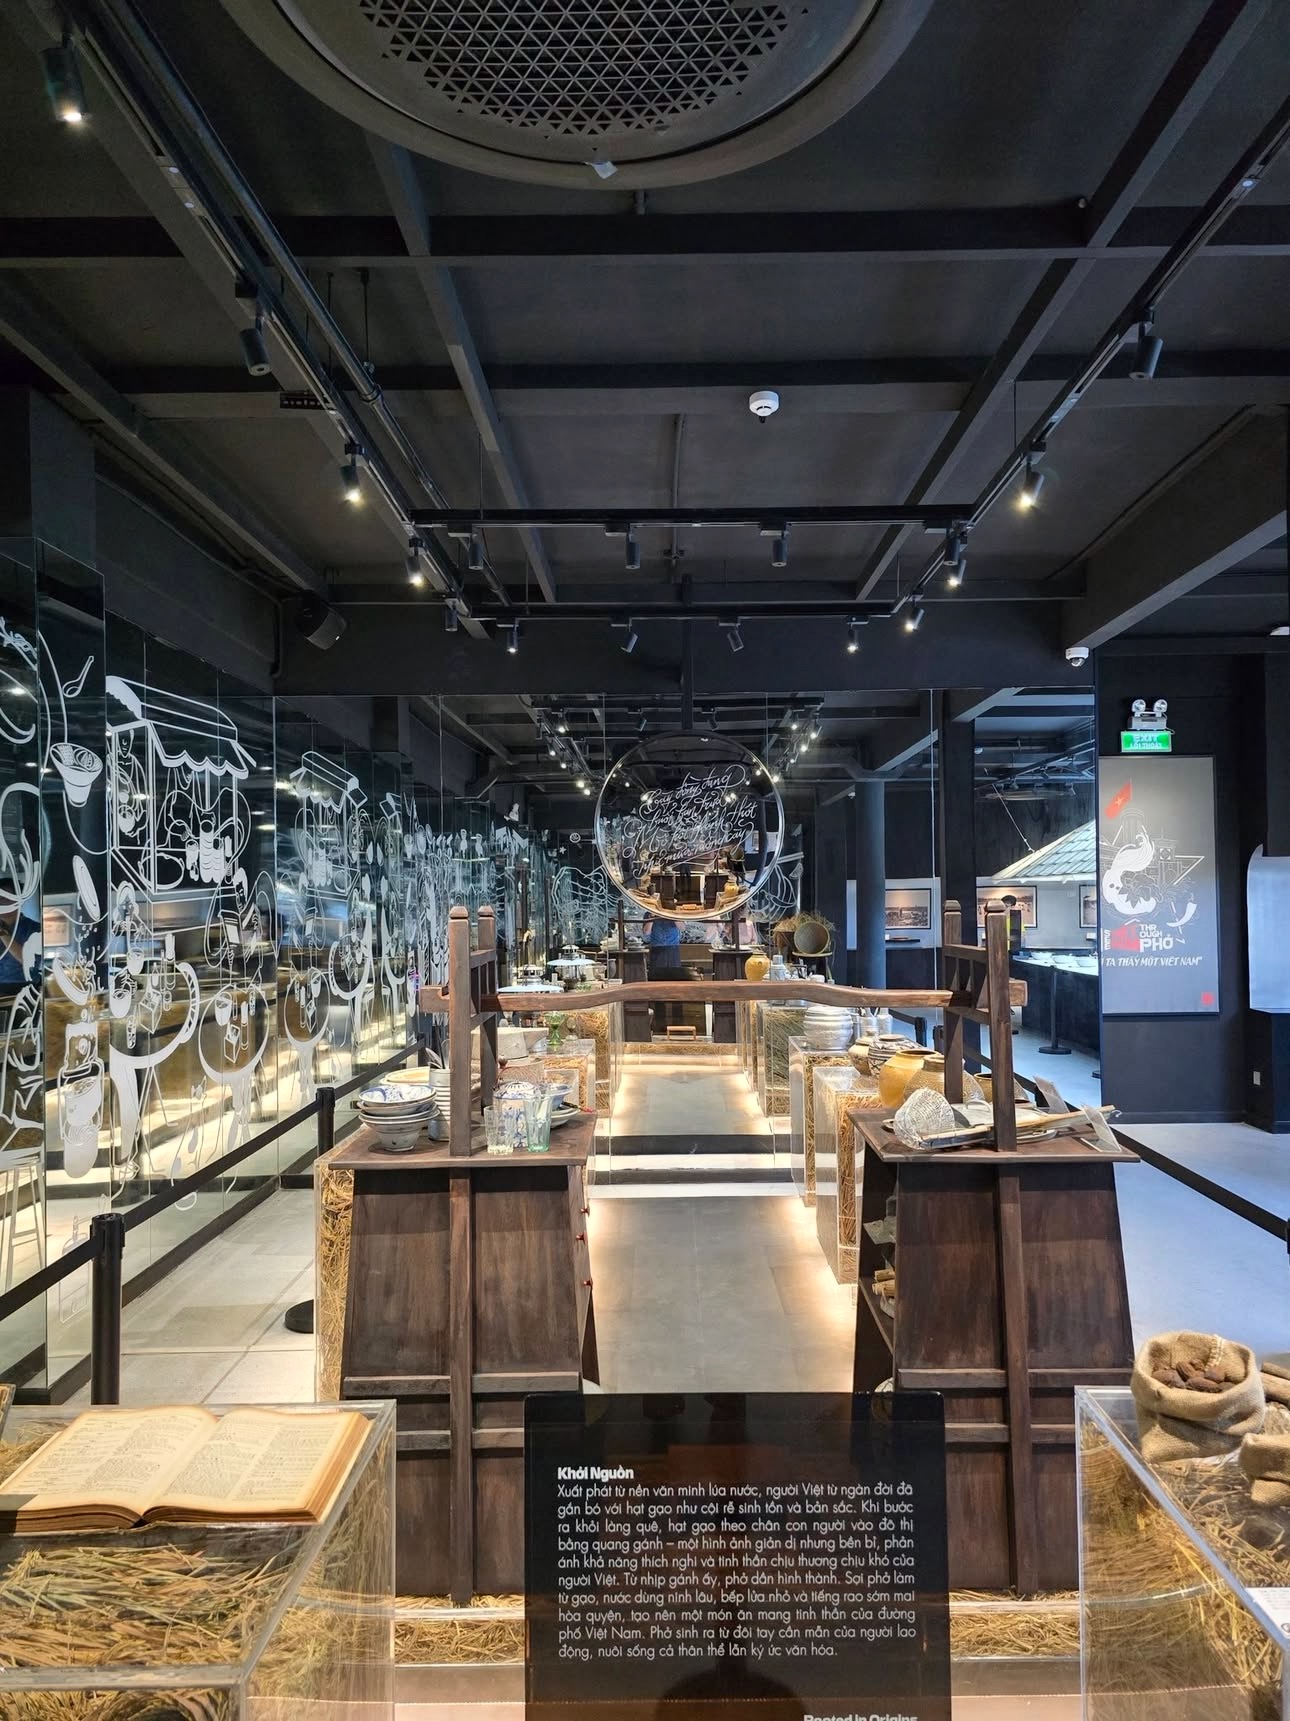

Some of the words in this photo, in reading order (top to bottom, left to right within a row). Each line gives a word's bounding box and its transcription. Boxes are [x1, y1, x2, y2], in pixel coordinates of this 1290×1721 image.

[1140, 930, 1162, 938] OUGH
[1105, 957, 1116, 967] TA
[558, 1466, 588, 1480] Khởi
[590, 1465, 634, 1482] Nguồn
[558, 1484, 583, 1497] Xuất
[586, 1484, 612, 1501] phát
[615, 1485, 625, 1497] từ
[653, 1485, 674, 1496] văn
[678, 1482, 705, 1496] minh
[709, 1482, 726, 1496] lúa
[730, 1484, 761, 1500] nước,
[766, 1484, 798, 1499] người
[802, 1482, 824, 1500] Việt
[827, 1484, 838, 1495] từ
[841, 1483, 870, 1499] ngàn
[874, 1481, 893, 1495] đời
[897, 1481, 913, 1495] đã
[585, 1500, 601, 1515] bó
[605, 1503, 621, 1515] với
[627, 1500, 644, 1516] hạt
[648, 1505, 672, 1519] gạo
[677, 1500, 697, 1514] như
[701, 1502, 719, 1515] cội
[723, 1501, 735, 1514] rễ
[739, 1499, 761, 1514] sinh
[787, 1501, 801, 1513] và
[806, 1499, 828, 1513] bản
[862, 1499, 879, 1512] Khi
[884, 1499, 913, 1513] bước
[558, 1524, 570, 1533] ra
[576, 1518, 599, 1532] khỏi
[606, 1518, 630, 1536] làng
[636, 1521, 661, 1536] quê,
[669, 1518, 686, 1533] hạt
[692, 1522, 716, 1536] gạo
[721, 1517, 746, 1531] theo
[752, 1517, 780, 1531] chân
[786, 1522, 807, 1531] con
[813, 1519, 845, 1535] người
[851, 1519, 873, 1531] vào
[879, 1516, 895, 1531] đô
[900, 1516, 913, 1532] thị
[592, 1541, 629, 1554] quang
[633, 1535, 663, 1553] gánh
[678, 1538, 698, 1554] một
[702, 1535, 726, 1549] hình
[730, 1535, 751, 1549] ảnh
[755, 1537, 781, 1554] giản
[785, 1535, 796, 1550] dị
[885, 1534, 914, 1552] phản
[558, 1554, 579, 1568] ánh
[584, 1554, 604, 1568] khả
[609, 1557, 637, 1571] năng
[642, 1554, 668, 1567] thích
[672, 1553, 697, 1572] nghi
[701, 1555, 715, 1567] và
[719, 1553, 738, 1567] tinh
[771, 1553, 794, 1568] chịu
[798, 1553, 837, 1571] thương
[841, 1552, 865, 1568] chịu
[869, 1552, 889, 1566] khó
[893, 1554, 914, 1566] của
[559, 1574, 590, 1590] người
[595, 1572, 619, 1587] Việt.
[624, 1572, 637, 1585] Từ
[641, 1571, 665, 1590] nhịp
[669, 1571, 698, 1590] gánh
[702, 1572, 720, 1588] ấy,
[725, 1571, 748, 1588] phở
[778, 1570, 801, 1584] hình
[805, 1570, 840, 1584] thành.
[845, 1571, 864, 1586] Sợi
[868, 1570, 890, 1588] phở
[894, 1570, 914, 1584] làm
[559, 1592, 569, 1604] từ
[571, 1595, 598, 1607] gạo,
[603, 1592, 631, 1603] nước
[634, 1589, 664, 1607] dùng
[668, 1589, 692, 1603] ninh
[696, 1589, 716, 1604] lâu,
[721, 1589, 744, 1606] bếp
[748, 1588, 765, 1602] lửa
[769, 1588, 790, 1602] nhỏ
[794, 1590, 808, 1602] và
[812, 1589, 839, 1607] tiếng
[844, 1593, 863, 1602] rao
[867, 1590, 890, 1602] sớm
[894, 1591, 914, 1601] mai
[559, 1608, 581, 1622] hòa
[586, 1610, 625, 1625] quyện,
[631, 1610, 650, 1622] tạo
[655, 1610, 676, 1621] nên
[682, 1609, 702, 1622] một
[708, 1609, 732, 1620] món
[737, 1610, 752, 1620] ăn
[758, 1611, 791, 1624] mang
[796, 1606, 816, 1620] tinh
[851, 1608, 873, 1620] của
[878, 1606, 915, 1623] đường
[559, 1625, 581, 1643] phố
[586, 1626, 607, 1640] Việt
[612, 1626, 645, 1639] Nam.
[651, 1625, 672, 1639] Phở
[676, 1625, 698, 1639] sinh
[703, 1630, 714, 1638] ra
[719, 1627, 729, 1638] từ
[733, 1624, 752, 1638] đôi
[757, 1627, 774, 1641] tay
[834, 1626, 855, 1638] của
[860, 1626, 892, 1641] người
[898, 1624, 916, 1637] lao
[559, 1644, 592, 1661] động,
[598, 1646, 622, 1657] nuôi
[627, 1644, 655, 1660] sống
[659, 1644, 674, 1656] cả
[679, 1642, 703, 1656] thân
[708, 1642, 725, 1656] thể
[729, 1642, 746, 1656] lẫn
[768, 1644, 781, 1656] ức
[785, 1645, 806, 1656] văn
[811, 1642, 837, 1656] hóa.
